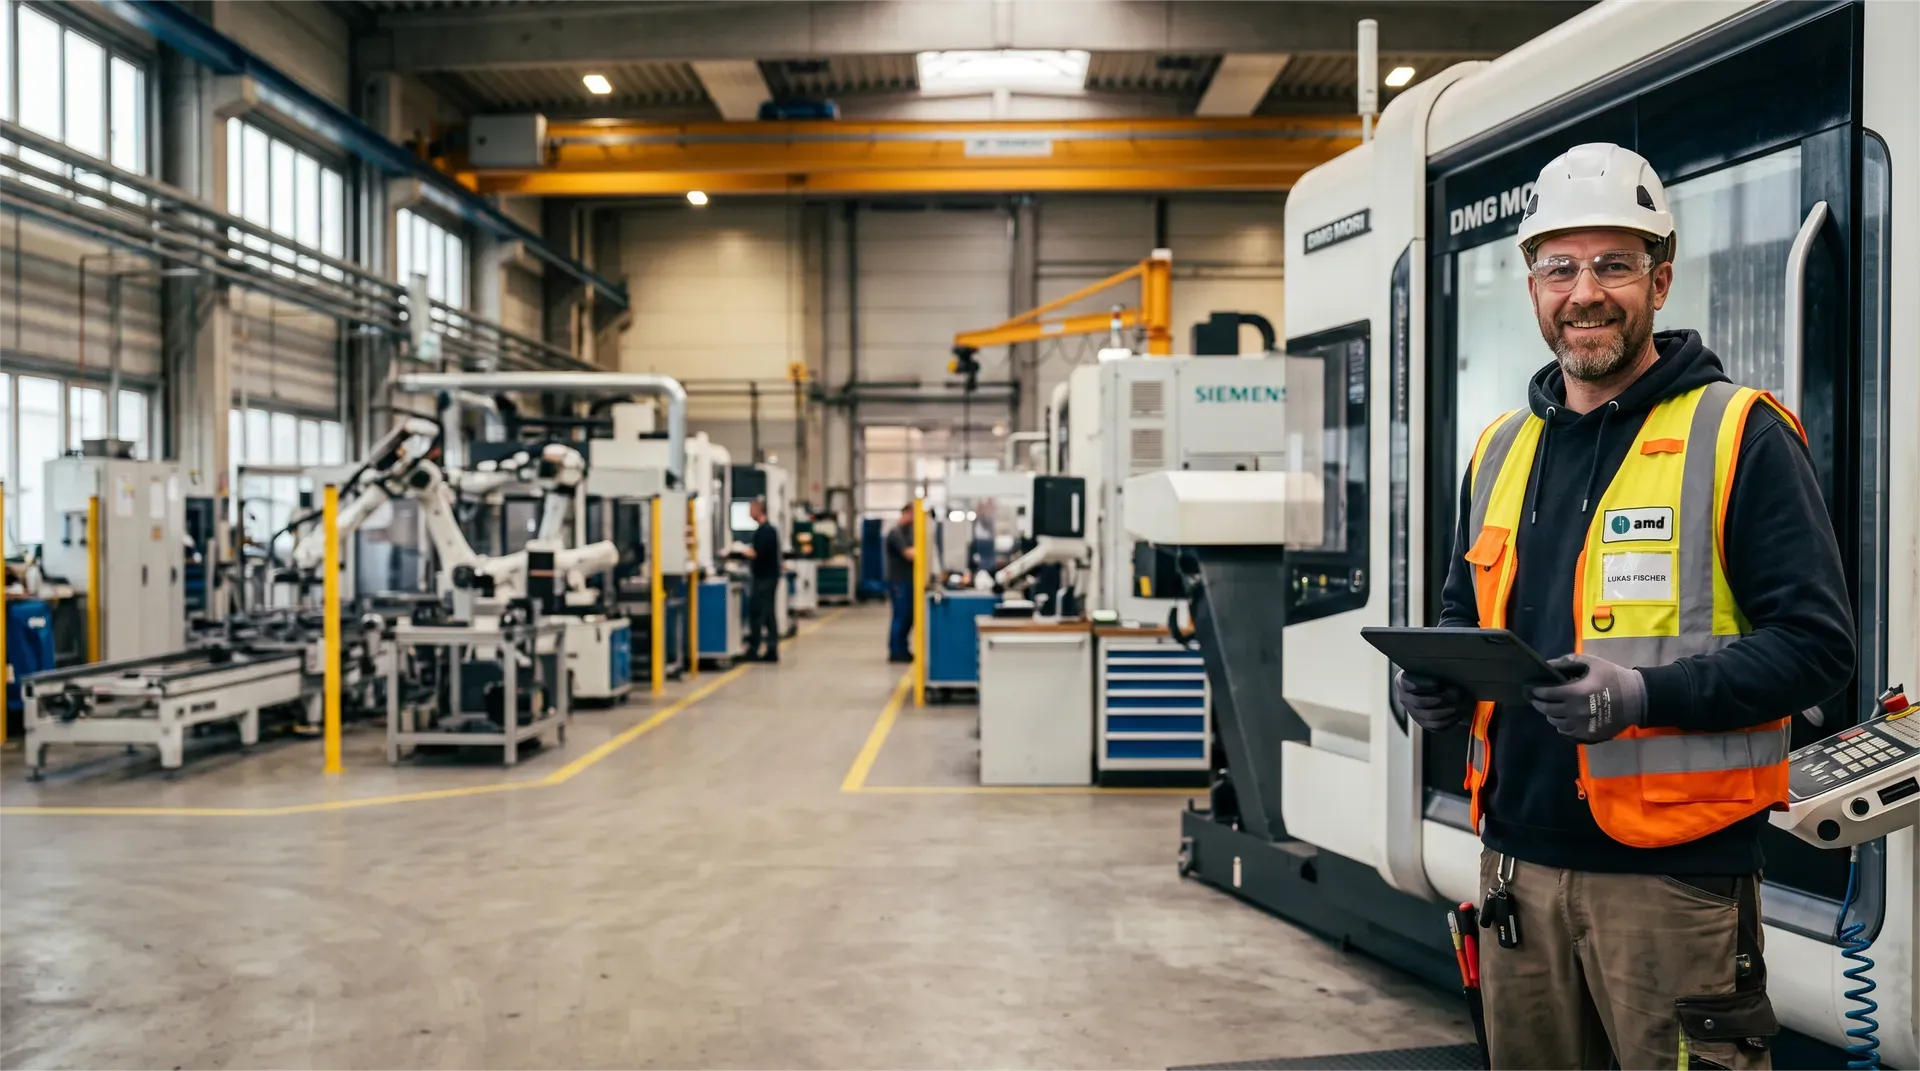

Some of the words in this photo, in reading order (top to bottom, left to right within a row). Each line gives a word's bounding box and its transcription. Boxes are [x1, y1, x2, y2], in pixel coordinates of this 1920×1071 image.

[1450, 196, 1497, 236] DMG
[1500, 181, 1536, 219] MO
[1307, 225, 1334, 250] DMG
[1334, 213, 1365, 240] MORI
[1634, 516, 1665, 529] amd
[1633, 574, 1666, 582] FISCHER
